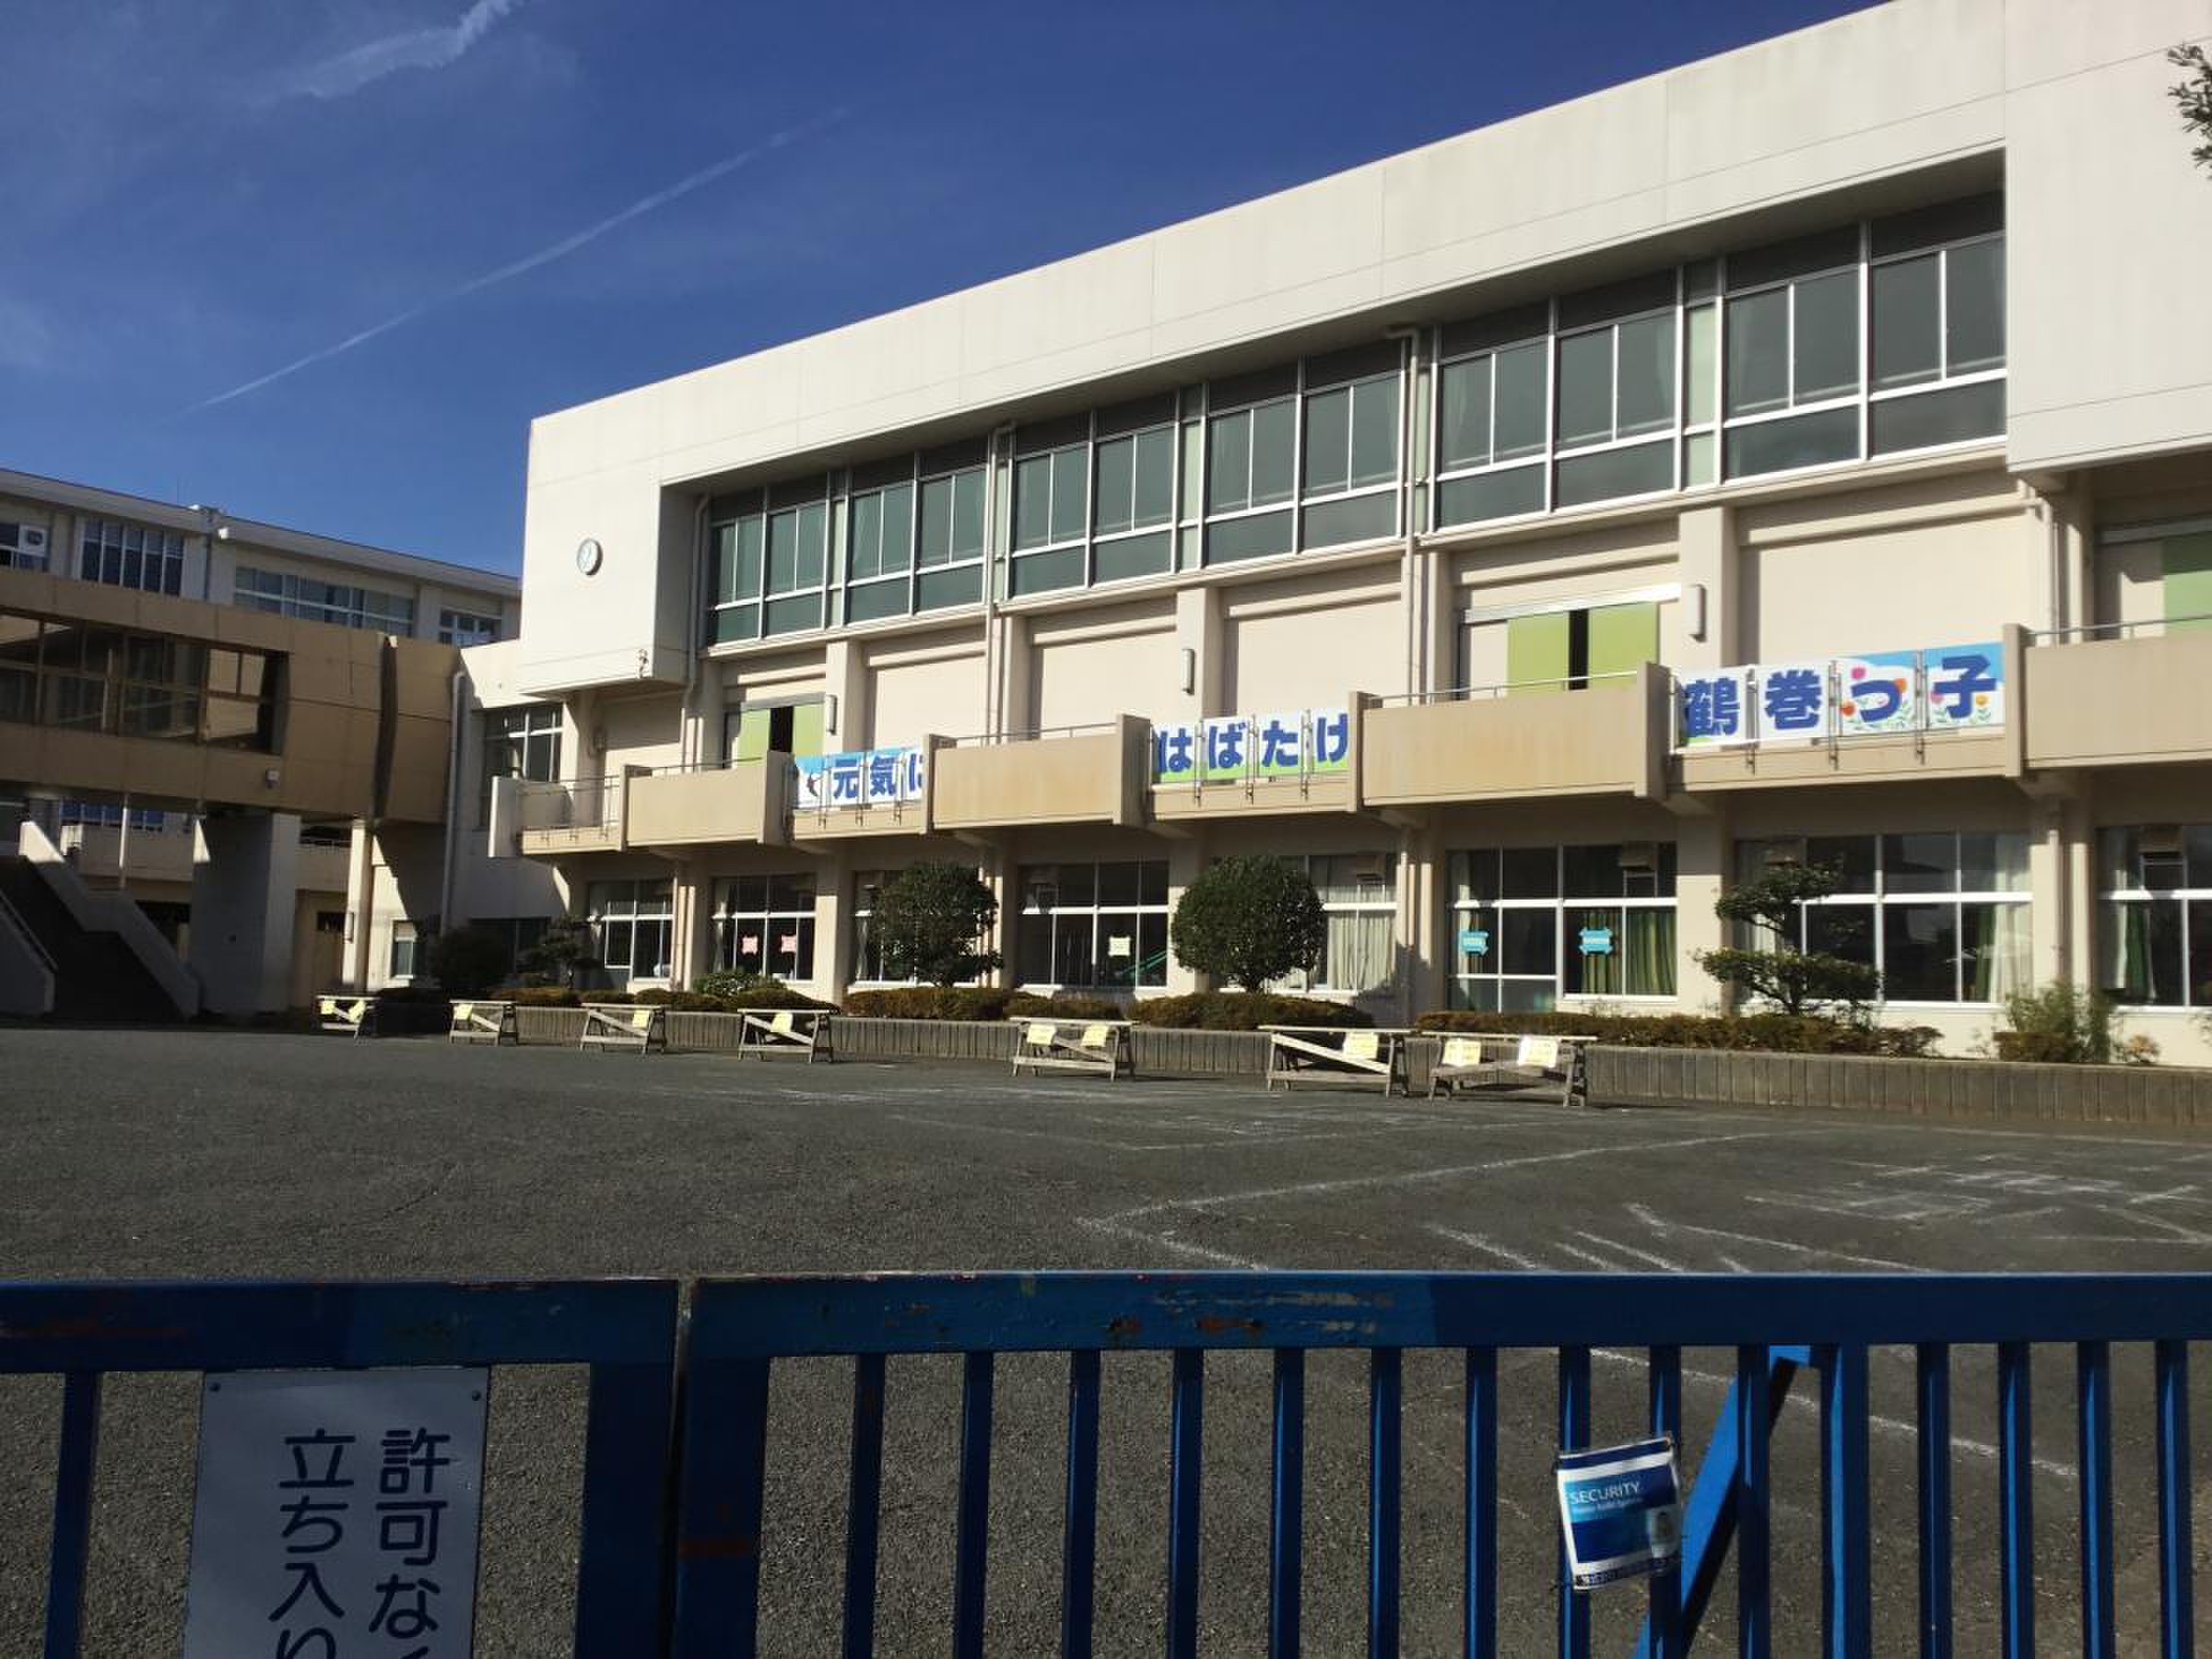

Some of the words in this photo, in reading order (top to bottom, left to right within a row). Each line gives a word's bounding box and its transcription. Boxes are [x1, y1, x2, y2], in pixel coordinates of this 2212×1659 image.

[1158, 712, 1348, 773] はばたけ
[1569, 1480, 1640, 1504] SECURITY
[369, 1428, 452, 1659] 許可な
